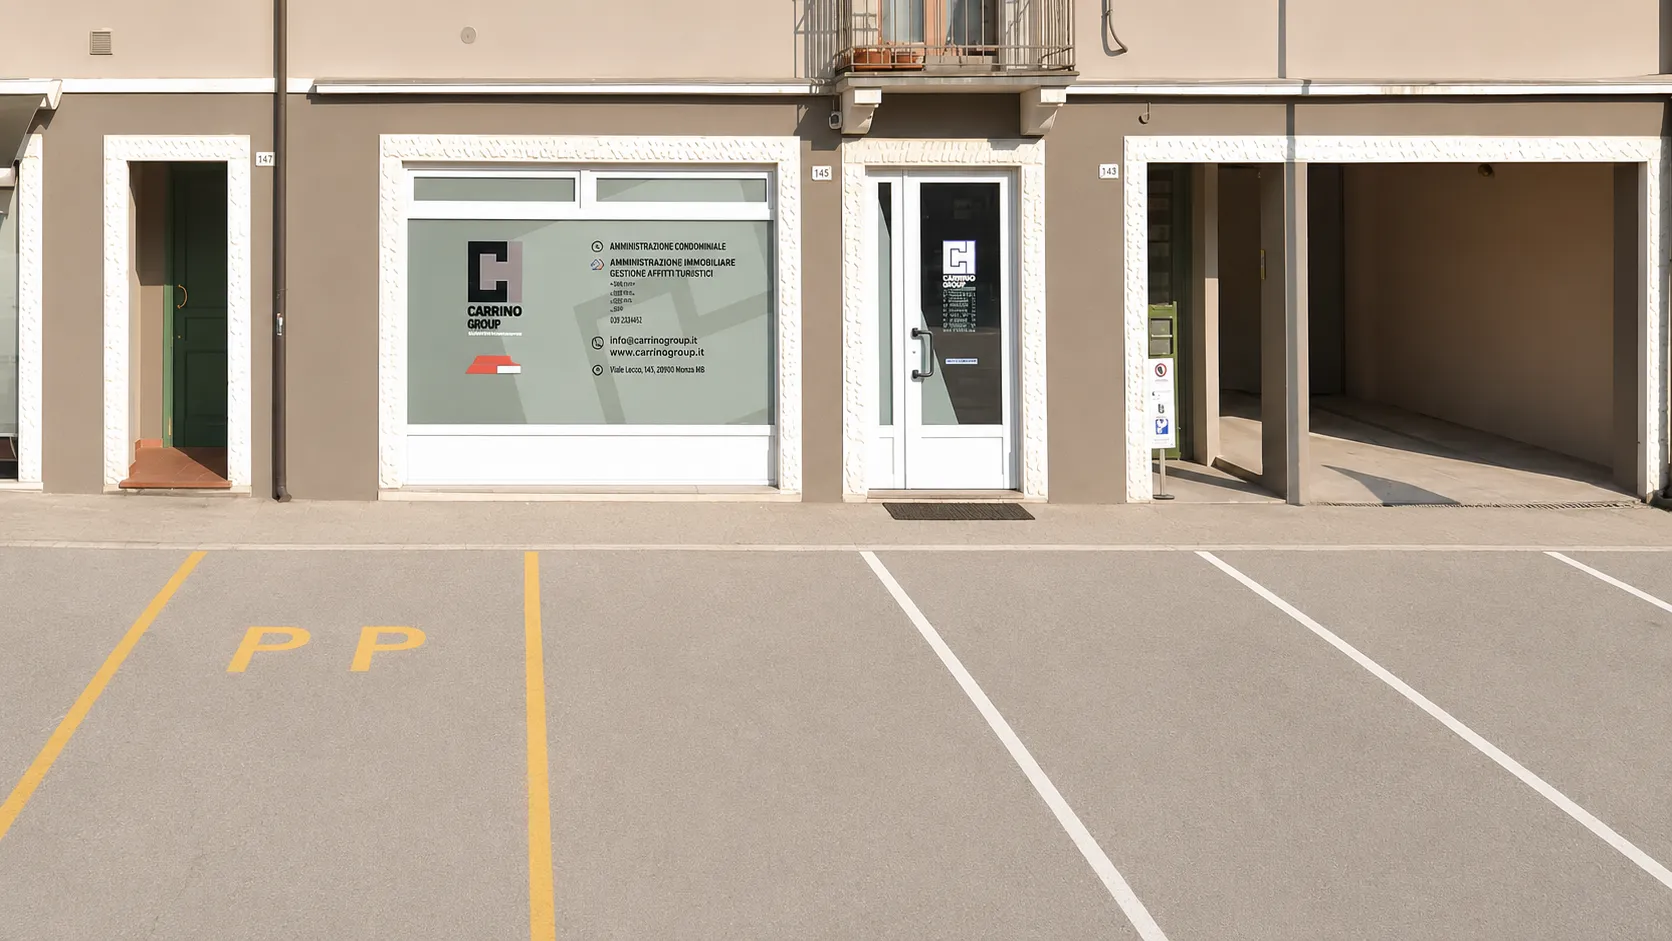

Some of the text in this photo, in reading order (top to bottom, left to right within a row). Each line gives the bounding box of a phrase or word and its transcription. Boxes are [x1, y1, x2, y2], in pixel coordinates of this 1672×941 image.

[258, 155, 273, 163] 147
[815, 168, 829, 178] 145
[1102, 167, 1117, 176] 143
[610, 242, 726, 250] AMMINISTRAZIONE CONDOMINIALE
[610, 258, 736, 266] AMMINISTRAZIONE IMMOBILIARE
[610, 270, 646, 278] GESTIONE
[647, 270, 674, 278] AFFITTI
[467, 305, 523, 317] CARRINO
[467, 318, 501, 329] GROUP
[609, 335, 698, 346] info@carrinogroup.it
[609, 347, 705, 358] www.carrinogroup.it
[609, 366, 624, 374] Viale
[226, 625, 427, 673] P P
